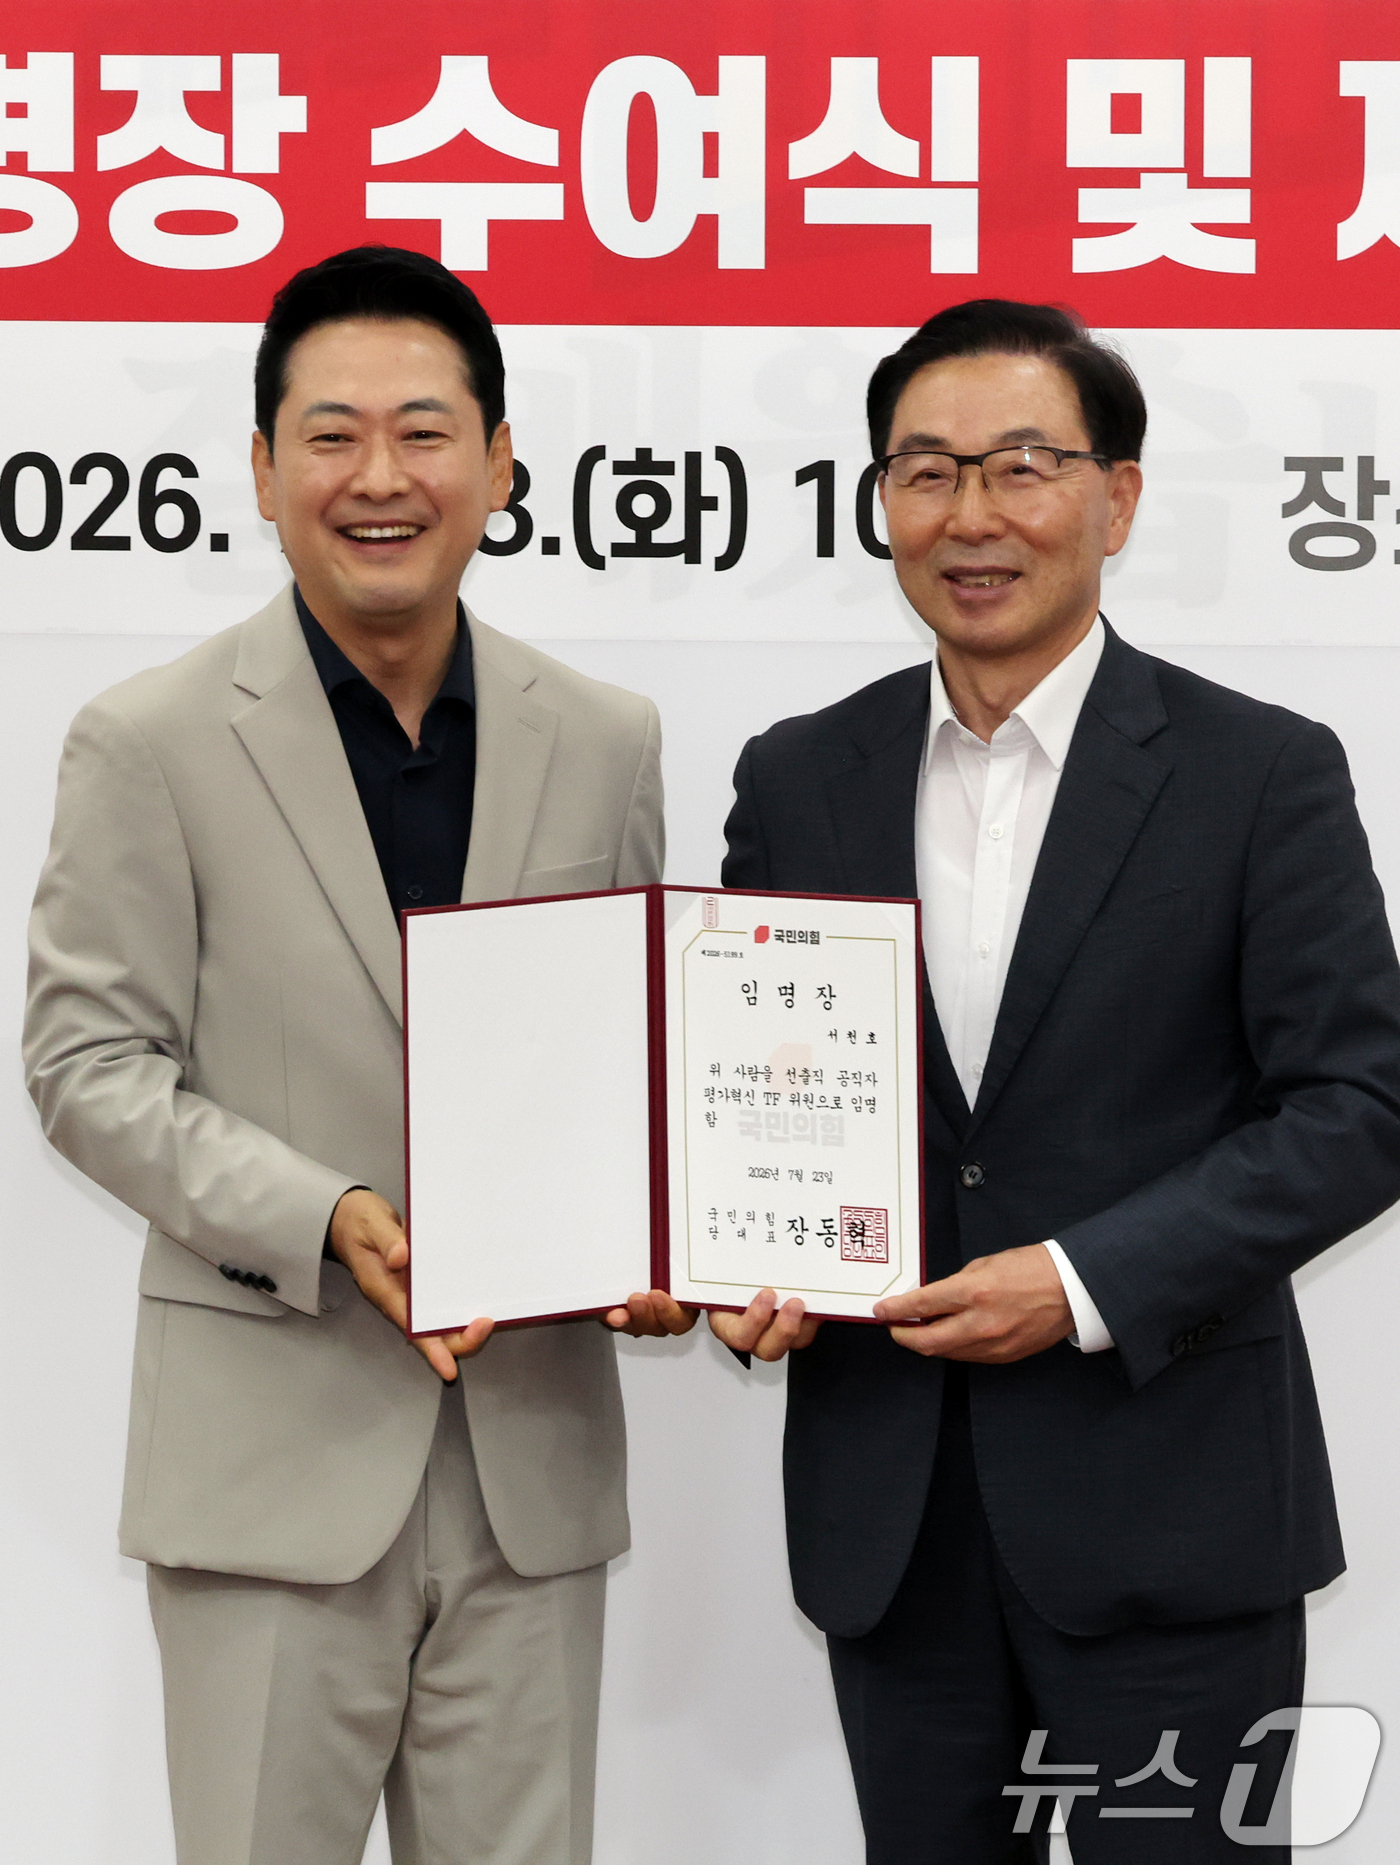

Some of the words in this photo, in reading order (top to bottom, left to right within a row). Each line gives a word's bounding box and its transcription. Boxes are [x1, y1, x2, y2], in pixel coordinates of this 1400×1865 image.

[366, 55, 979, 274] 수여식
[1066, 57, 1256, 274] 및
[1282, 456, 1400, 570] 장
[774, 929, 820, 945] 국민의힘
[709, 1062, 721, 1079] 위
[733, 1064, 773, 1083] 사람을
[785, 1067, 824, 1085] 선출직
[836, 1070, 878, 1088] 공직자
[704, 1086, 755, 1106] 평가혁신
[763, 1092, 781, 1106] TF
[789, 1092, 843, 1110] 위원으로
[851, 1095, 877, 1114] 임명
[704, 1111, 718, 1128] 함
[738, 1109, 845, 1147] 국민의힘
[748, 1166, 779, 1181] 2026년
[788, 1169, 803, 1183] 7월
